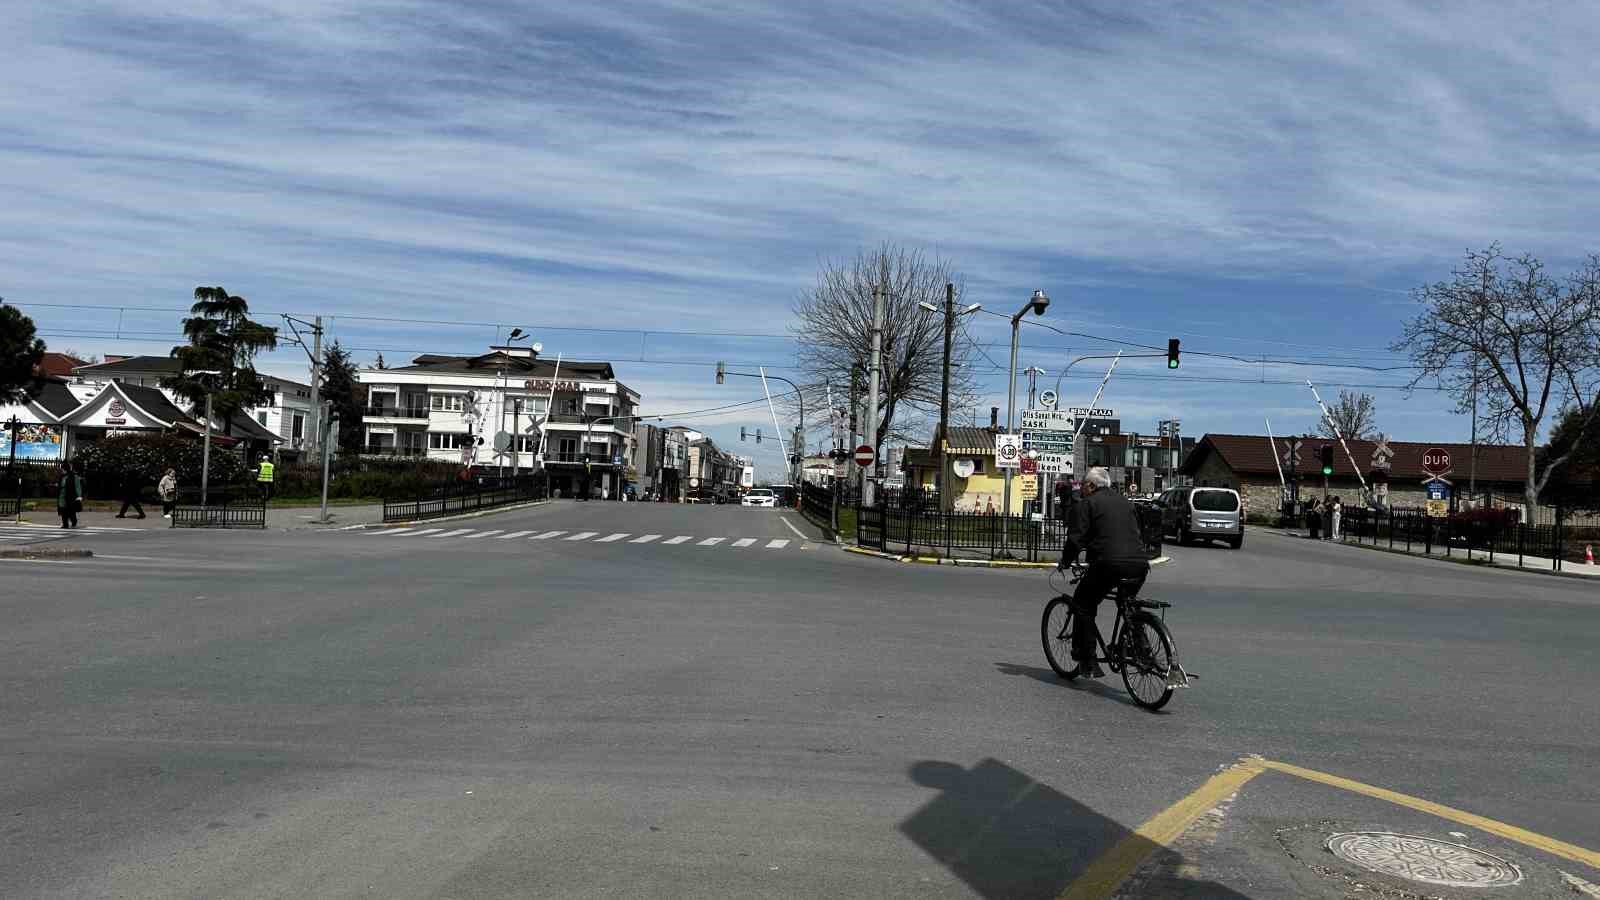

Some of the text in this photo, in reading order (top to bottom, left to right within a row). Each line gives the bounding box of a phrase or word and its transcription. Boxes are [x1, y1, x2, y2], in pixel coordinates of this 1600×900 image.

[1023, 420, 1047, 428] SASKİ
[1037, 454, 1061, 462] divan
[1425, 455, 1448, 465] DUR
